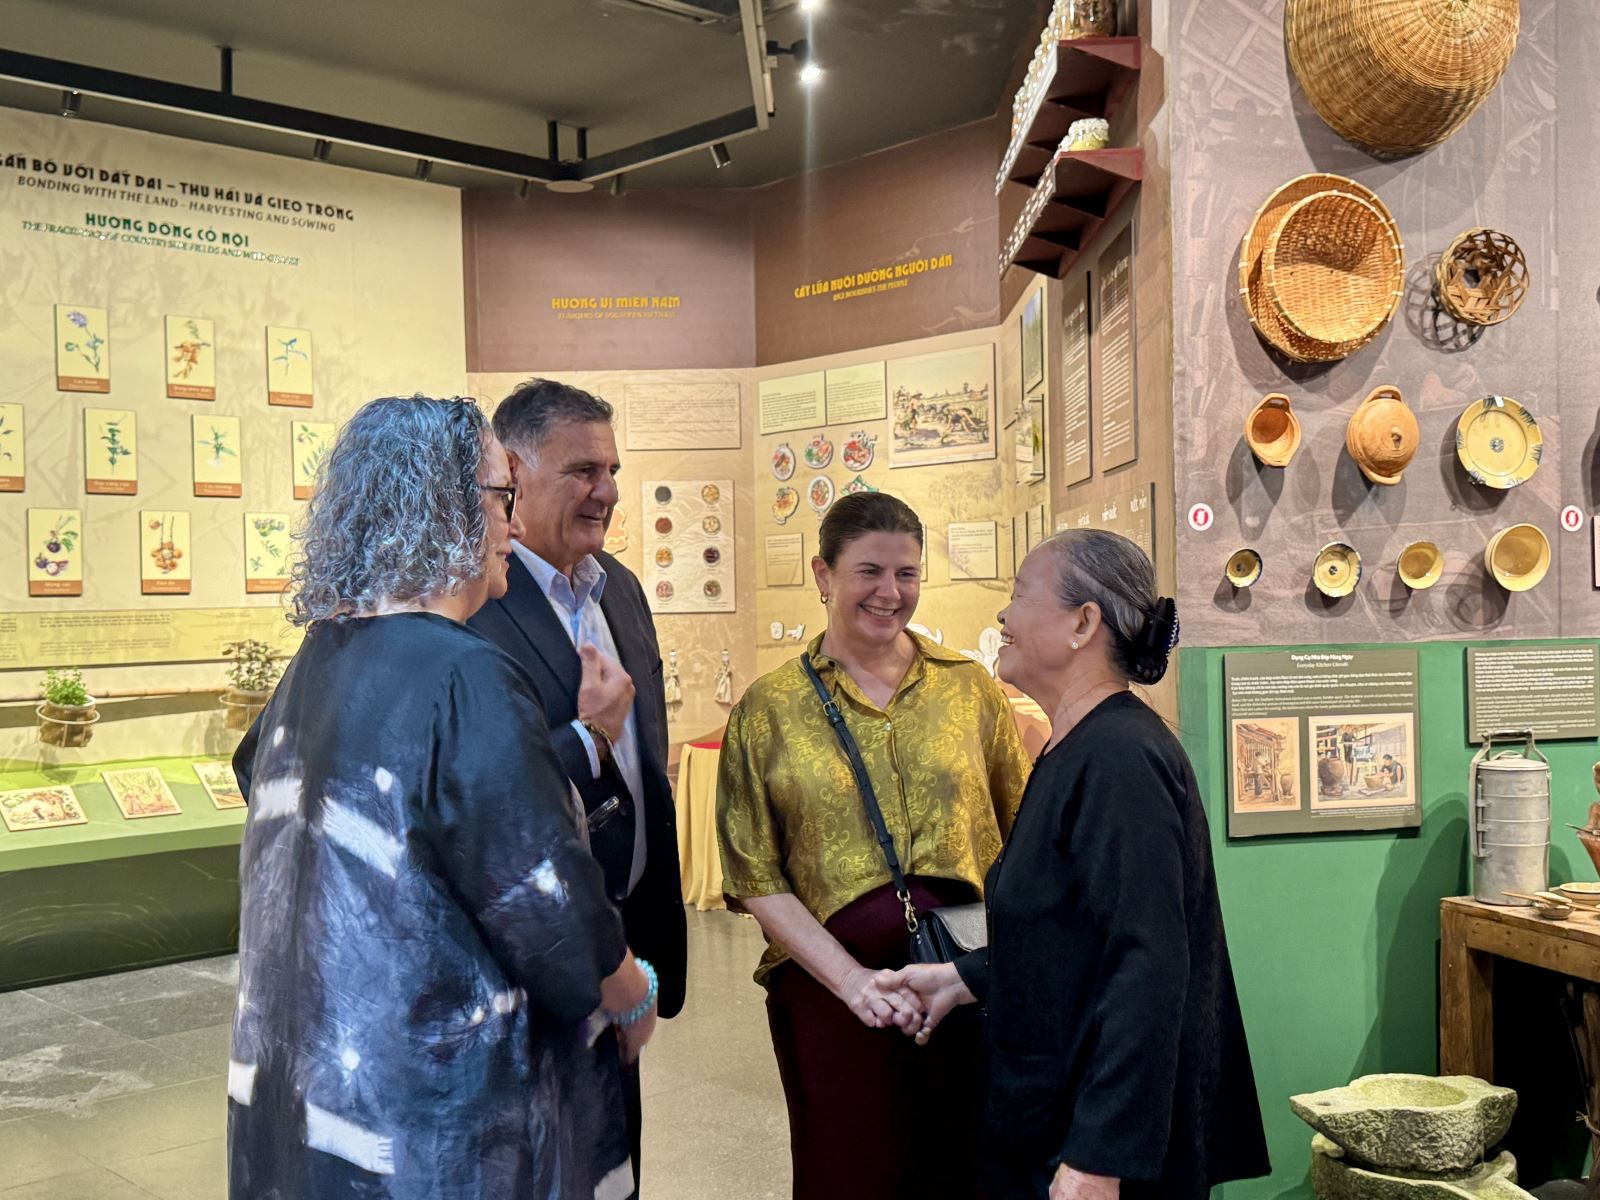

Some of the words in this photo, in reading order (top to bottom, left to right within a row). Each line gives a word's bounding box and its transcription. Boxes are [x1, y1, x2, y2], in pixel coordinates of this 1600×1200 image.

[18, 175, 80, 194] BONDING
[83, 185, 116, 199] WITH
[119, 190, 143, 203] THE
[145, 194, 178, 208] LAND
[188, 201, 264, 221] HARVESTING
[265, 213, 289, 225] AND
[292, 217, 336, 232] SOWING
[179, 182, 209, 198] THU
[267, 196, 302, 212] GIEO
